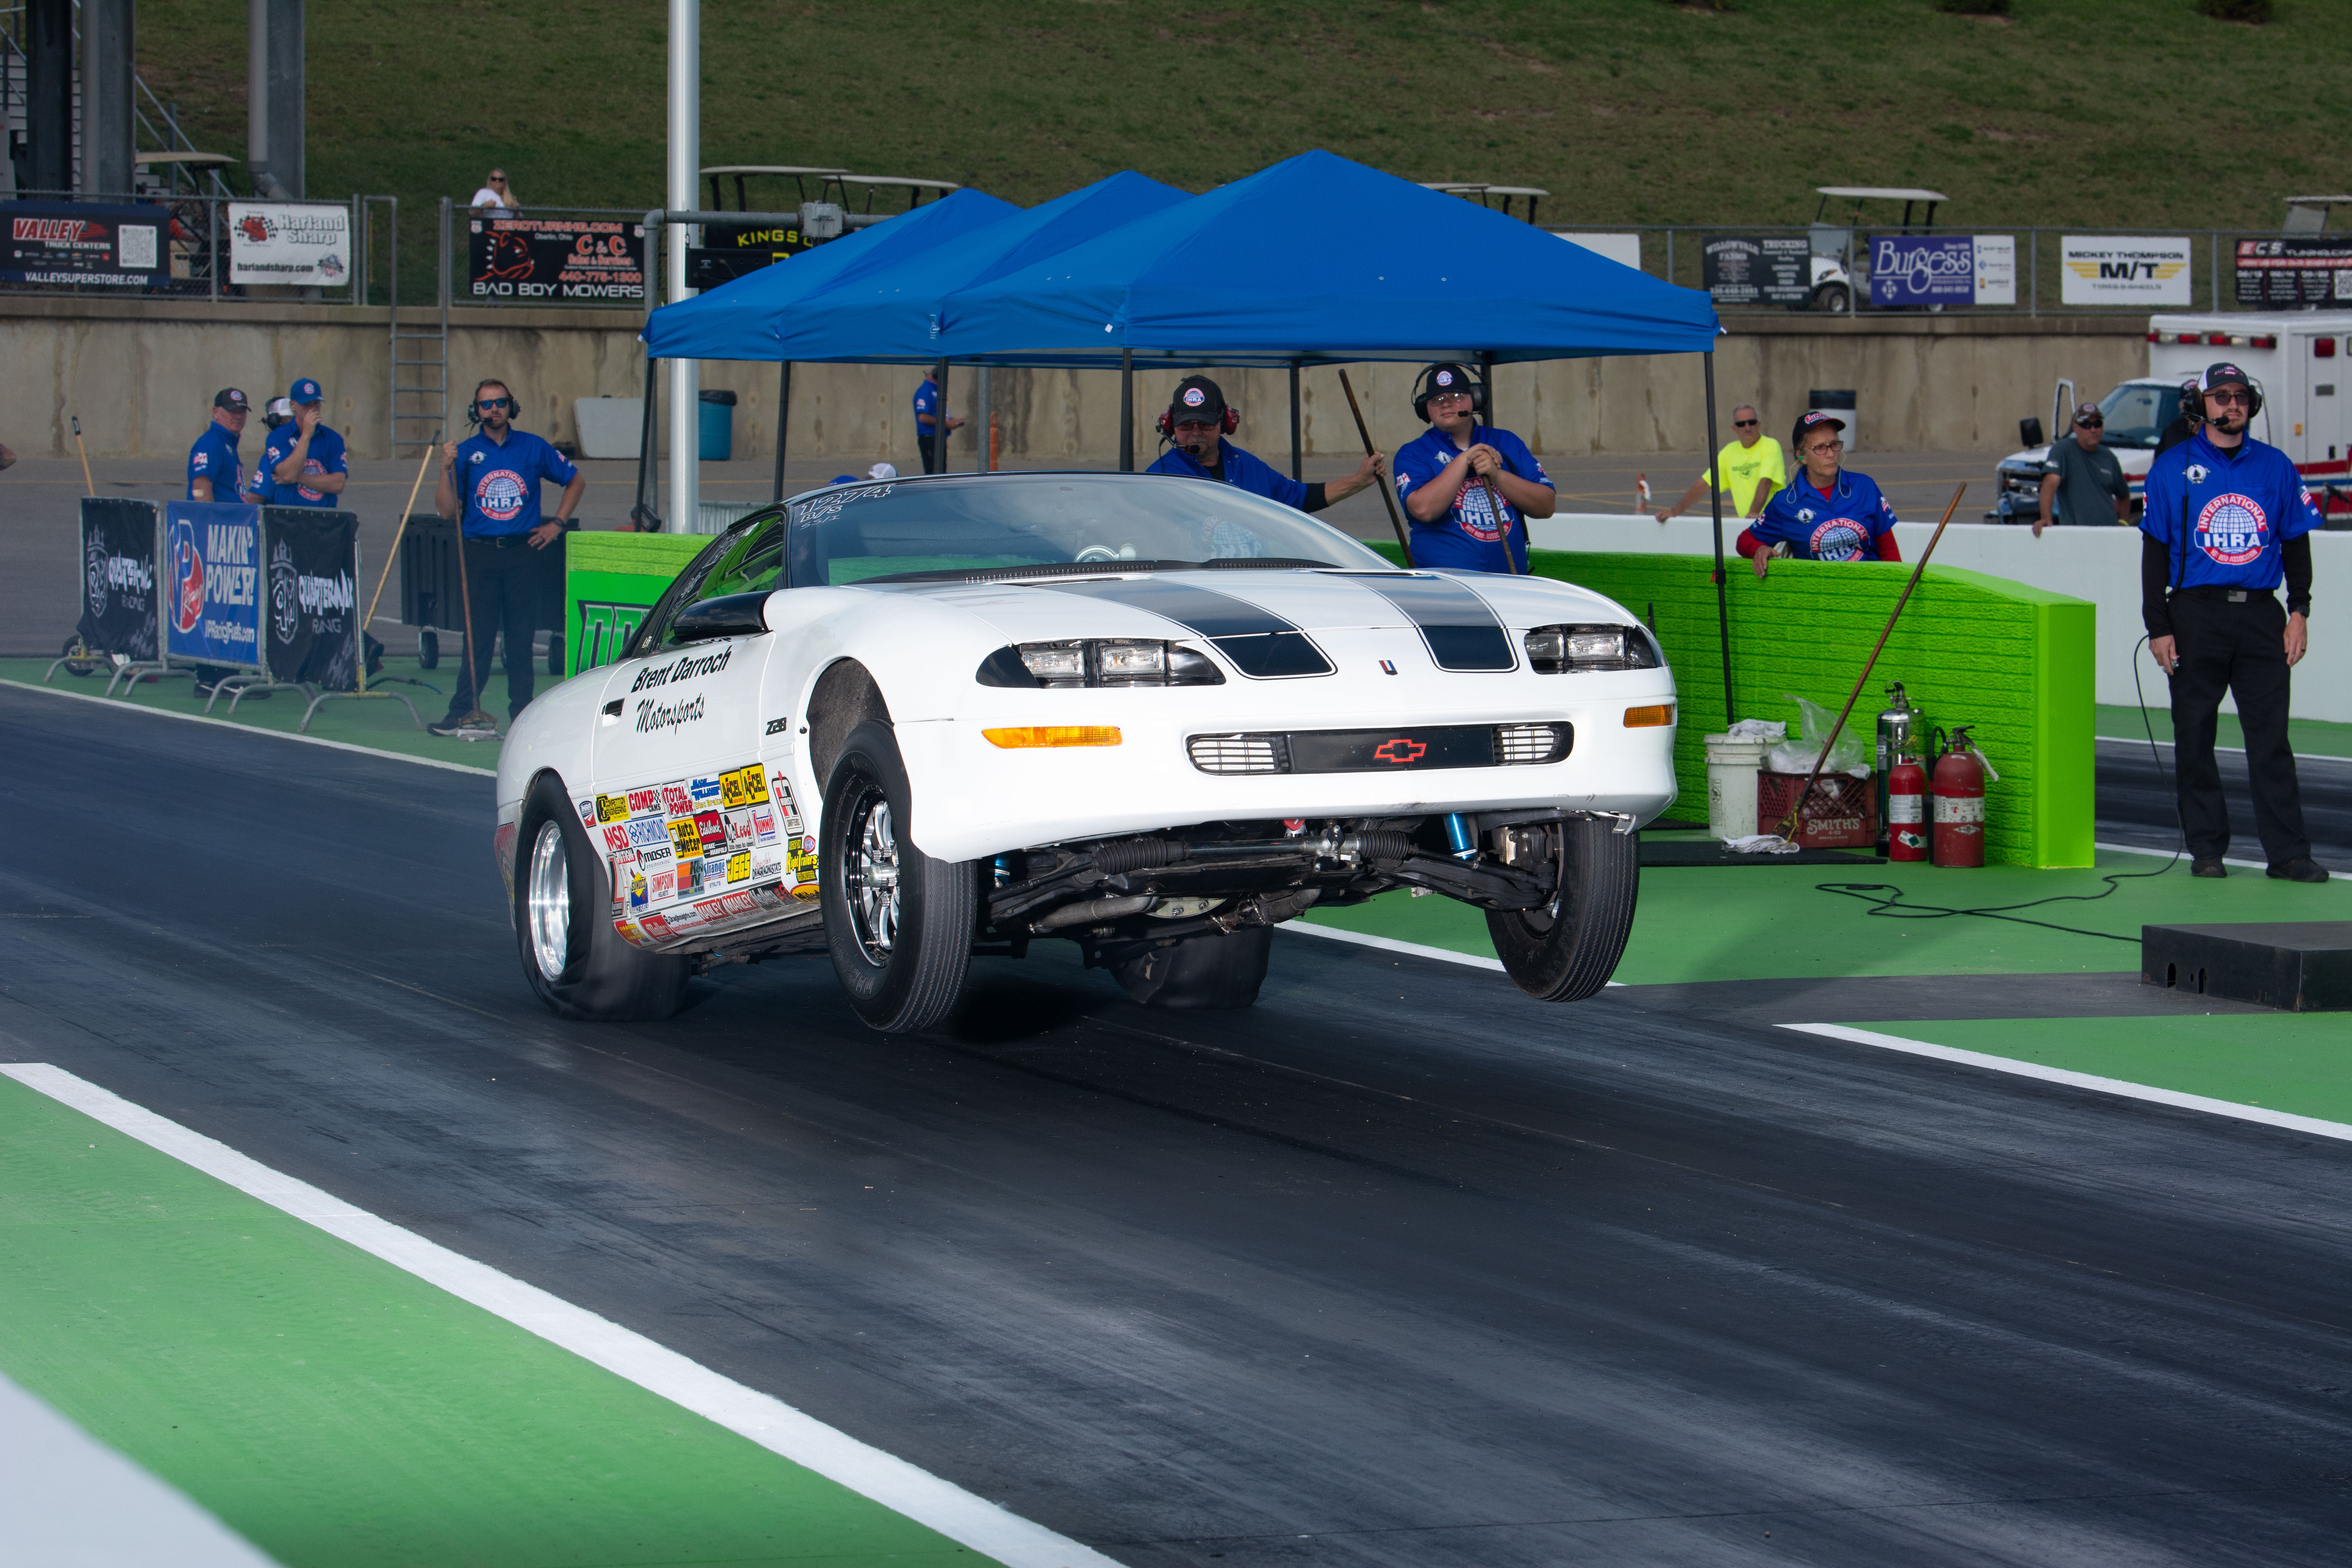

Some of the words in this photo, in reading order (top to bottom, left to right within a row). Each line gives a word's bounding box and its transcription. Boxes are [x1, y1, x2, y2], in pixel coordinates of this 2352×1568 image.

[13, 218, 85, 241] VALLEY
[278, 214, 345, 231] Harland
[45, 241, 71, 249] TRUCK
[72, 242, 111, 250] CENTERS
[287, 229, 337, 245] Sharp
[575, 234, 594, 255] C
[608, 235, 627, 255] C
[737, 229, 798, 247] KINGS
[237, 262, 314, 273] harlandsharp.com
[1875, 240, 1971, 294] Burgess
[2099, 260, 2160, 281] M/T
[25, 272, 148, 285] VALLEYSUPERSTORE.COM
[473, 282, 512, 295] BAD
[518, 283, 557, 296] BOY
[563, 284, 644, 298] MOWERS
[479, 471, 526, 494] INTERNATIONAL
[481, 496, 523, 508] IHRA
[800, 485, 892, 515] 1274
[1459, 509, 1510, 524] IHRA
[2199, 495, 2267, 529] INTERNATIONAL
[1811, 519, 1867, 547] INTERNATIONAL
[2203, 533, 2261, 547] IHRA
[205, 564, 256, 606] POWER!
[630, 660, 676, 693] Brent
[670, 645, 732, 683] Darroch
[636, 692, 705, 736] Motorsports
[765, 717, 788, 736] Z28
[663, 786, 687, 804] TOTAL
[860, 784, 881, 795] WELD
[605, 796, 625, 808] COMPETITION
[628, 789, 654, 812] COMP
[648, 803, 661, 813] CAMS
[669, 799, 694, 815] POWER
[694, 800, 706, 809] Disc
[706, 798, 725, 807] Brakes
[780, 797, 793, 806] HURST
[606, 805, 627, 817] ENGINEERING
[636, 818, 668, 843] RICHMOND
[677, 822, 694, 838] Auto
[699, 819, 722, 837] Edelbrock
[725, 820, 751, 841] McLeod
[602, 824, 630, 851] MSD
[680, 837, 700, 853] Meter
[804, 839, 814, 850] NHRA
[644, 847, 672, 862] MOSER
[703, 842, 715, 851] INTAKE
[710, 846, 727, 856] MANIFOLD
[646, 859, 670, 869] ENGINEERING
[704, 860, 725, 877] Strange
[727, 851, 751, 883] JEGS
[631, 878, 647, 892] SUNOCO
[652, 872, 674, 893] SIMPSON
[694, 901, 726, 920] MANLEY
[724, 893, 756, 913] MANLEY
[668, 911, 698, 922] DragInsights.com
